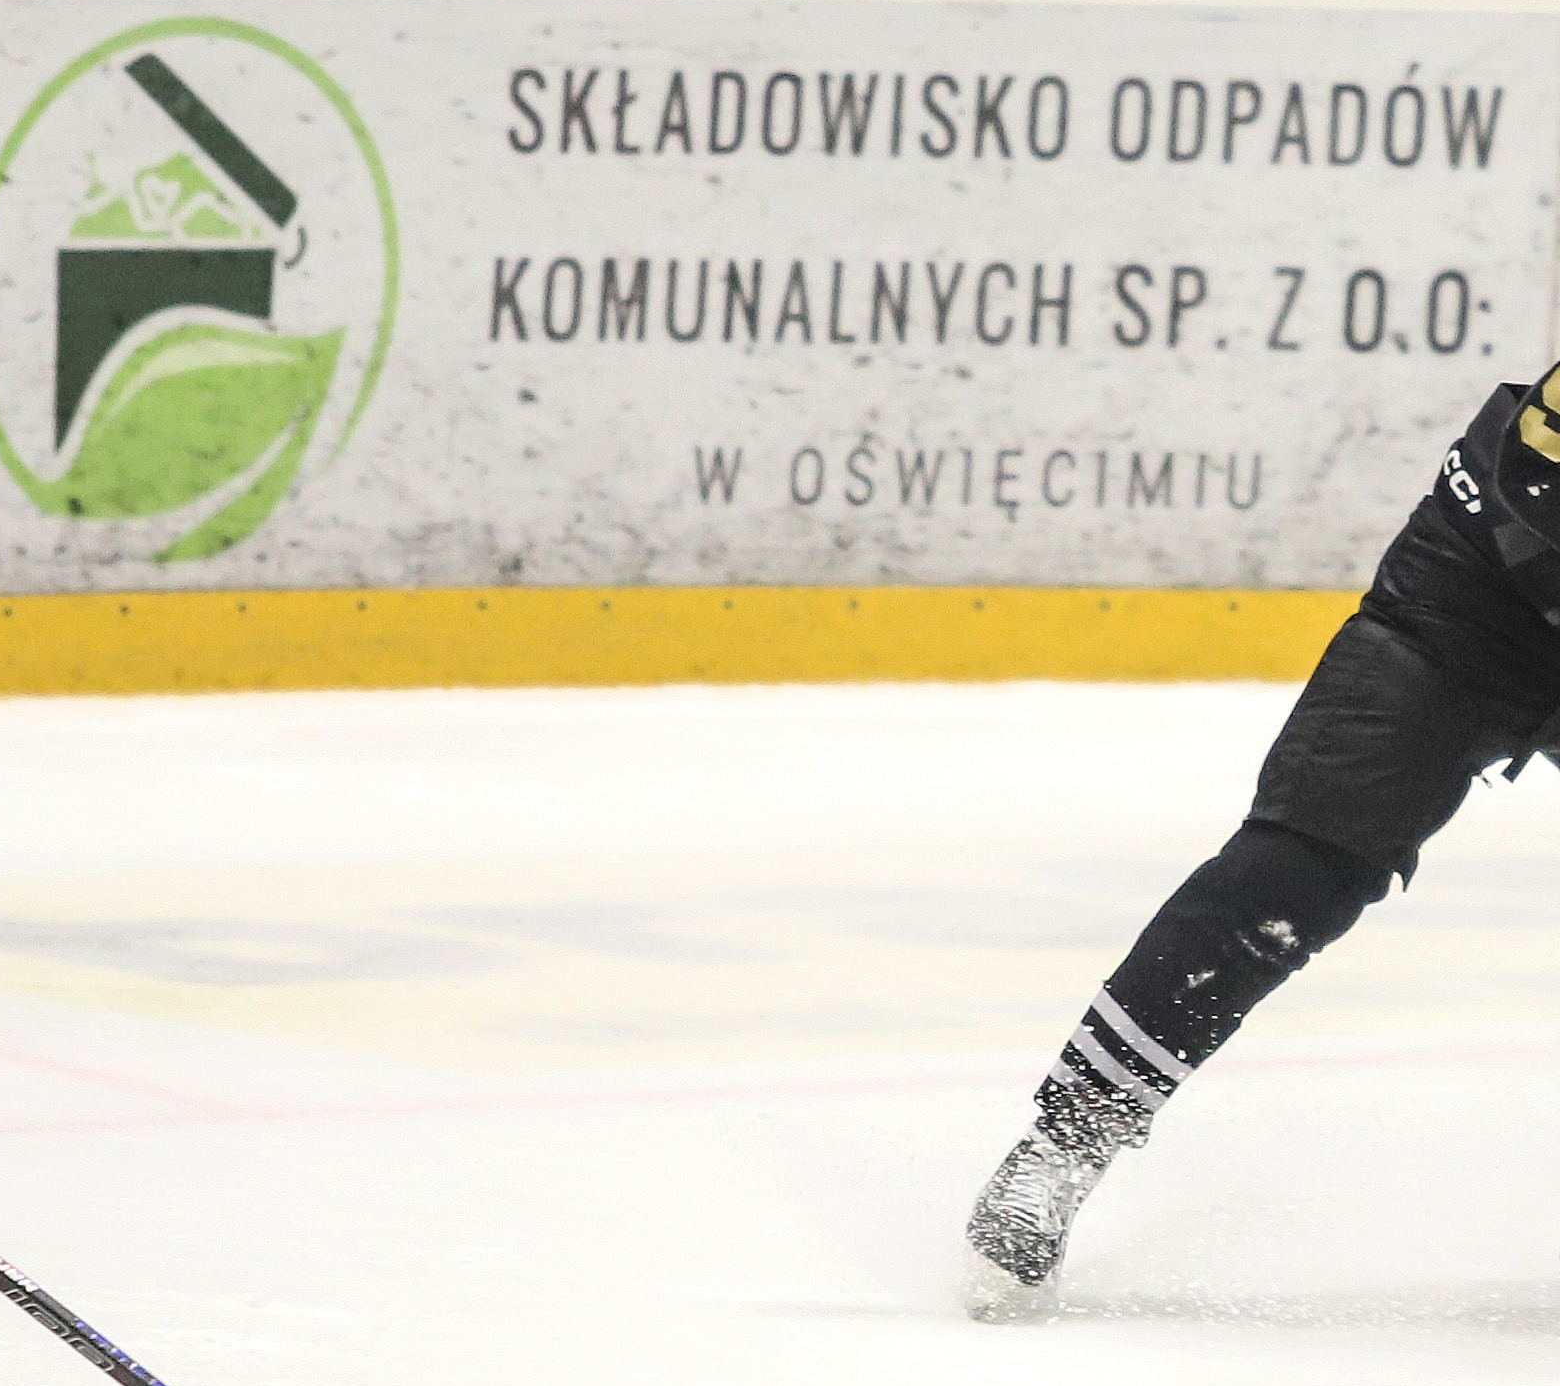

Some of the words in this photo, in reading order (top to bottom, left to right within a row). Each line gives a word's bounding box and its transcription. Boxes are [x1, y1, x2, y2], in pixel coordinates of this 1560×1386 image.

[504, 66, 1070, 162] SKŁADOWISKO
[1107, 61, 1504, 170] ODPADÓW
[488, 256, 1073, 349] KOMUNALNYCH
[1111, 263, 1229, 353] SP.
[1266, 266, 1304, 353] Z
[691, 444, 745, 506] W
[790, 434, 1265, 522] OŚWIĘCIMIU
